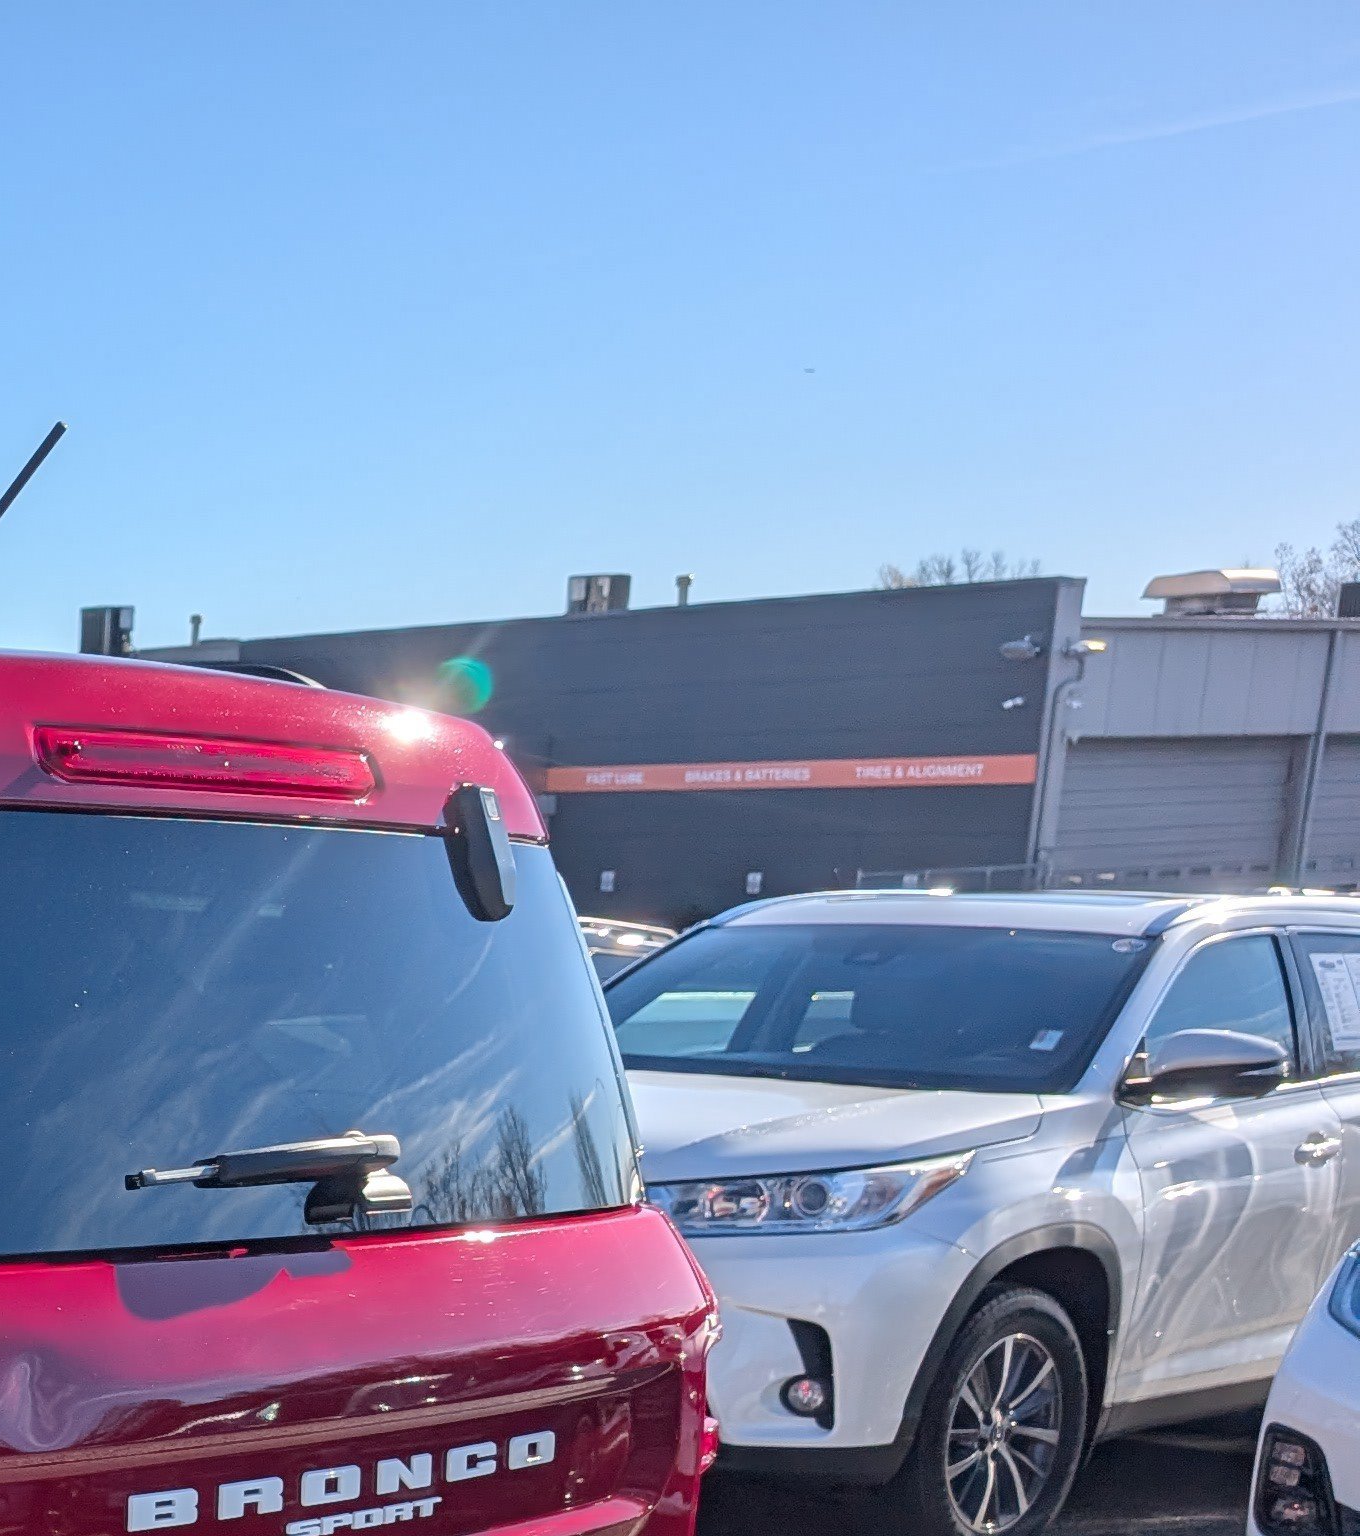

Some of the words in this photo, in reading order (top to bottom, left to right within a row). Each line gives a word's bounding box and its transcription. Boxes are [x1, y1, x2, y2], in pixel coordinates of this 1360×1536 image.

[586, 772, 613, 785] FAST
[684, 769, 731, 783] BRAKES
[744, 767, 810, 781] BATTERIES
[855, 765, 892, 779] TIRES
[907, 763, 984, 778] ALIGNMENT
[127, 1429, 556, 1533] BRONCO
